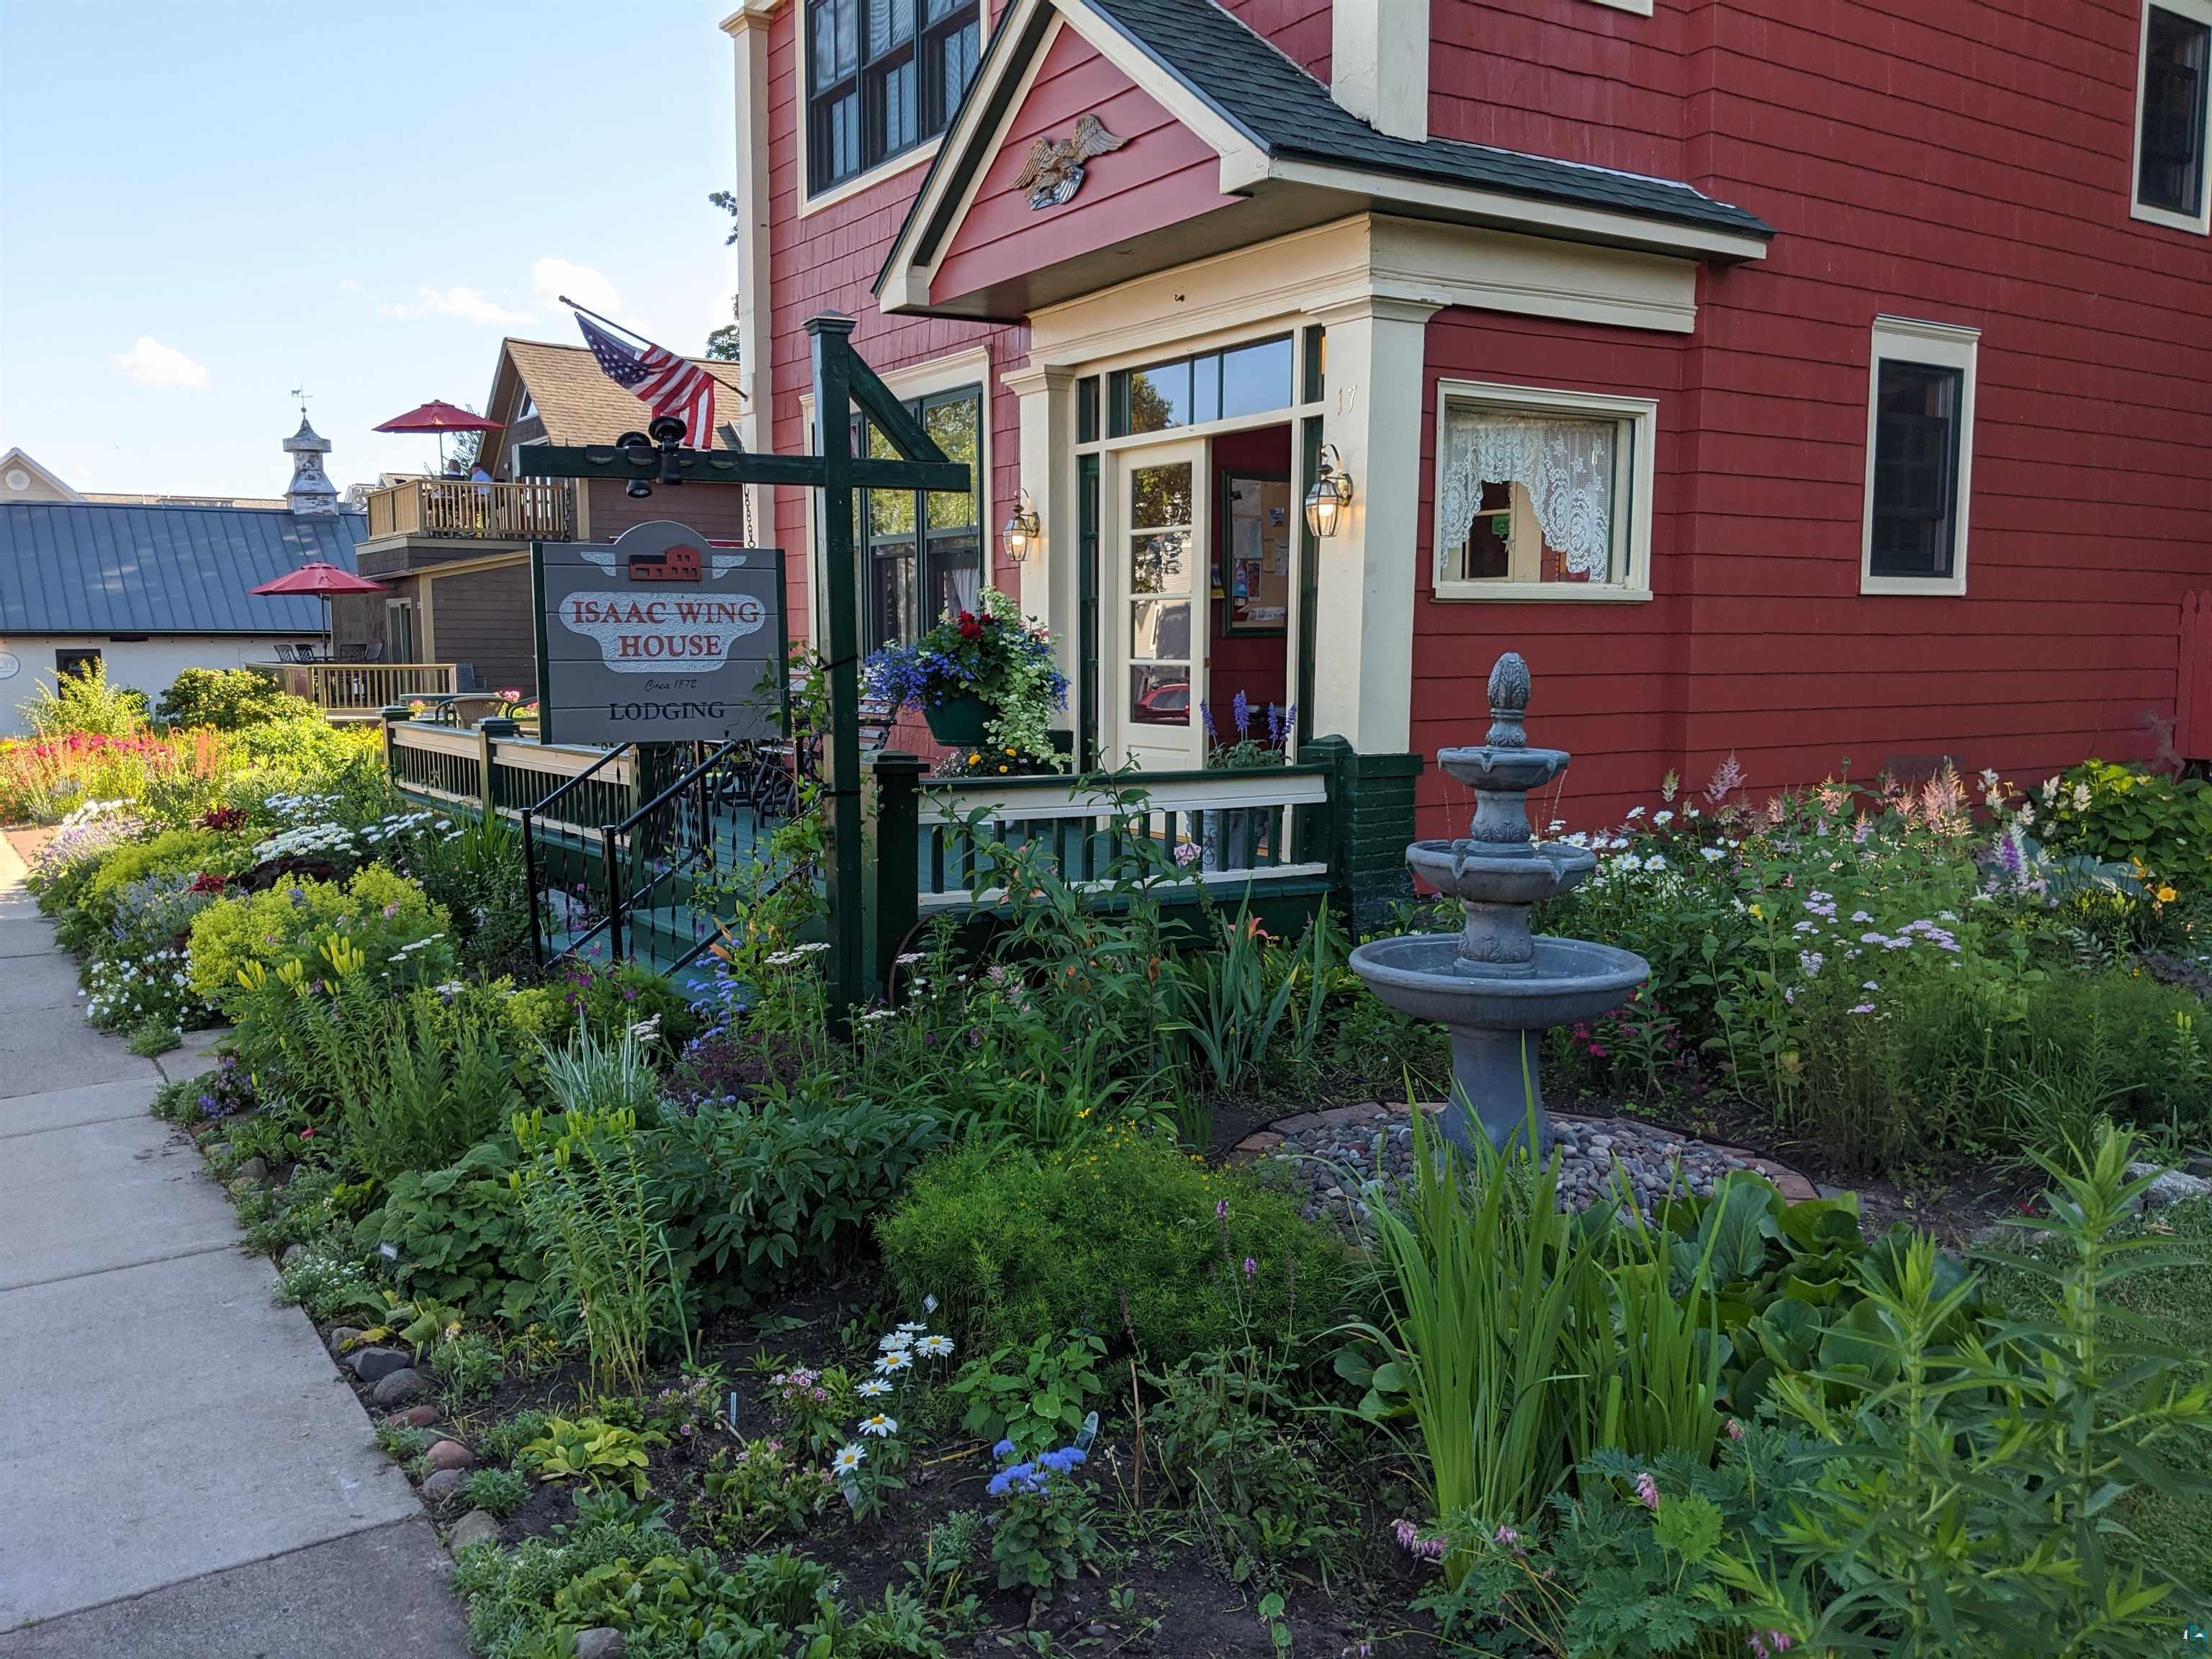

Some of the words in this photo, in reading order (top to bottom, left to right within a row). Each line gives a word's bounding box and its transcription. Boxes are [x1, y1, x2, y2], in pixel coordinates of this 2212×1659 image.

[1336, 385, 1357, 415] 17
[572, 601, 667, 624] ISAAC
[675, 602, 760, 624] WING
[618, 634, 723, 657] HOUSE
[644, 679, 670, 692] Circa
[674, 679, 698, 690] 1872
[608, 701, 726, 721] LODGING
